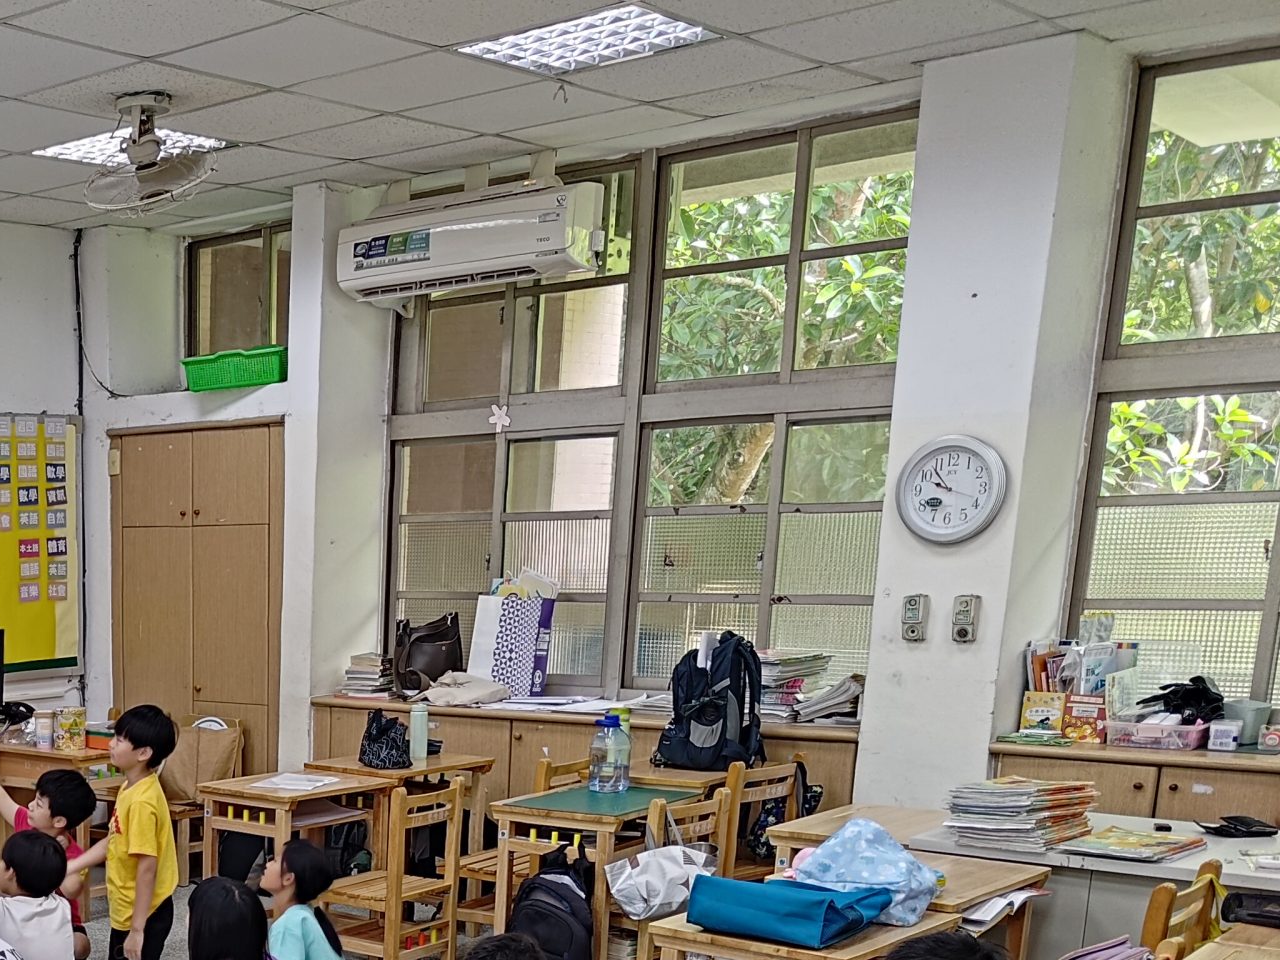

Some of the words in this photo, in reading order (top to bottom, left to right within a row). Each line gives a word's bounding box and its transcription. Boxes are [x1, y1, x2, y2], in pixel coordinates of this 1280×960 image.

[18, 443, 36, 456] 國語
[46, 444, 65, 457] 國語
[934, 457, 944, 471] 11
[947, 453, 960, 467] 12
[967, 456, 971, 469] 1
[18, 465, 37, 478] 國語
[46, 465, 65, 479] 數學
[921, 469, 933, 482] 10
[975, 466, 984, 479] 2
[914, 484, 922, 497] 9
[978, 481, 987, 494] 3
[18, 488, 38, 502] 數學
[918, 499, 927, 512] 8
[971, 497, 980, 509] 4
[20, 512, 38, 525] 英語
[47, 511, 65, 525] 自然
[930, 508, 938, 522] 7
[943, 512, 952, 525] 6
[960, 508, 968, 521] 5
[19, 544, 39, 553] 本土語
[48, 540, 66, 553] 體育
[20, 562, 39, 576] 國語
[48, 563, 66, 576] 英語
[20, 586, 39, 598] 音樂
[48, 583, 66, 597] 社會
